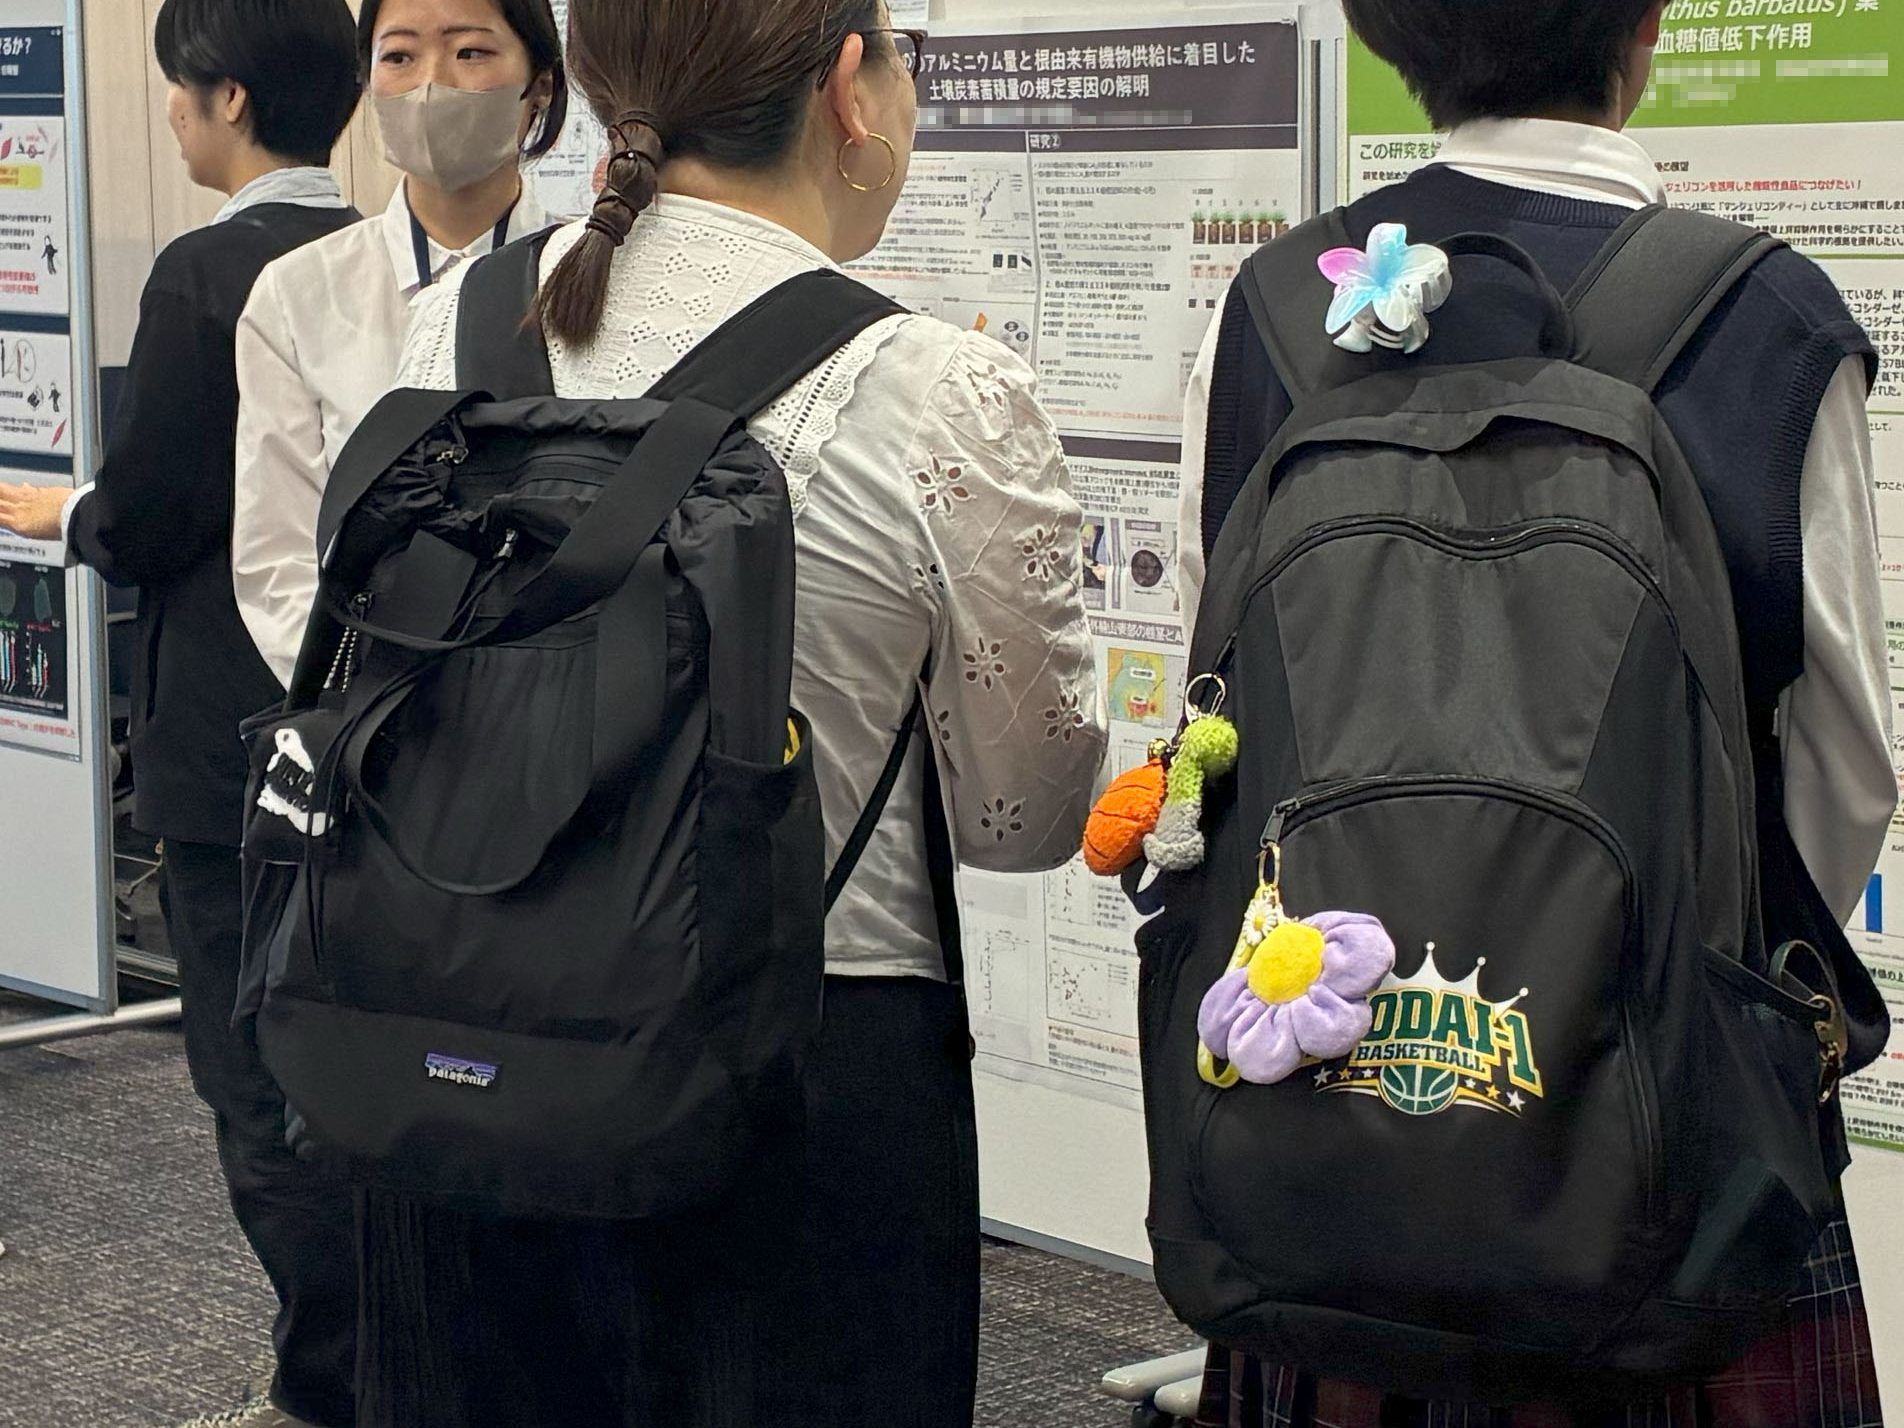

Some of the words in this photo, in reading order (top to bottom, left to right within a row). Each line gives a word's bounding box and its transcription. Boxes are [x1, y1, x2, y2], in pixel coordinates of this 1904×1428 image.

[1654, 22, 1813, 55] 血糖値低下作用
[1355, 1043, 1486, 1074] BASKETBALL
[426, 1066, 493, 1088] patagonia
